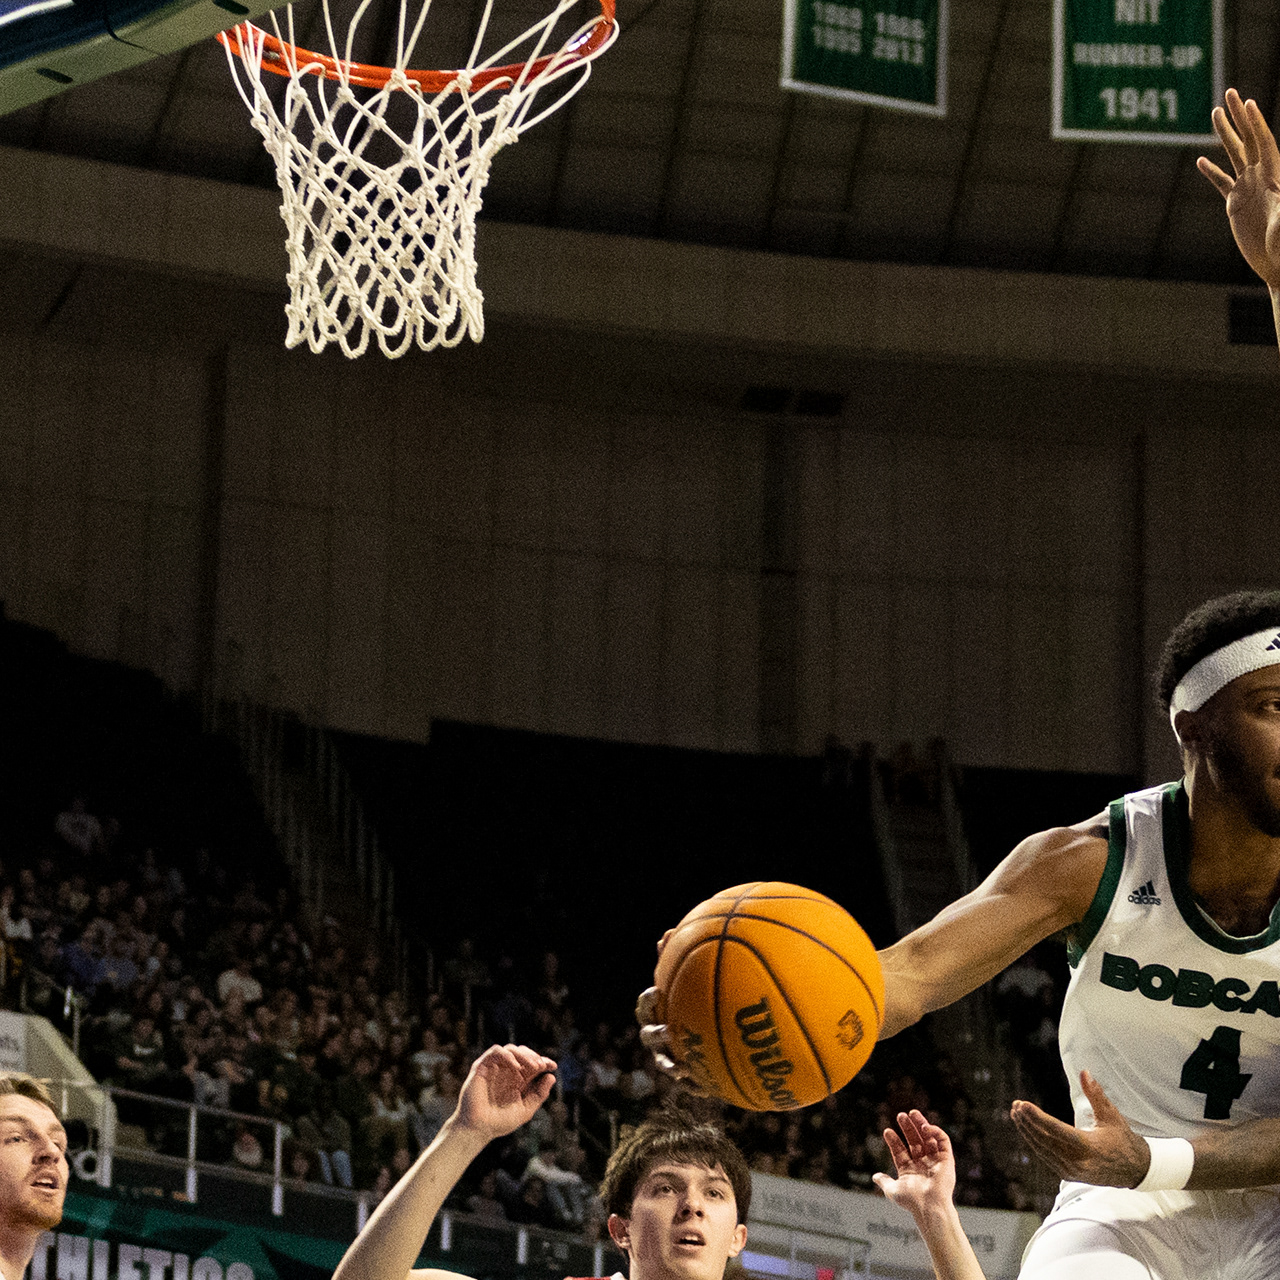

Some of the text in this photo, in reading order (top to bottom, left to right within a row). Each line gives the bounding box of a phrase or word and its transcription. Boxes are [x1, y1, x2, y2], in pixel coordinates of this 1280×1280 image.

[1114, 0, 1164, 25] NIT
[1073, 42, 1204, 69] RUNNER-UP
[1099, 87, 1178, 121] 1941
[1128, 894, 1161, 906] adidas
[1180, 1026, 1253, 1119] 4
